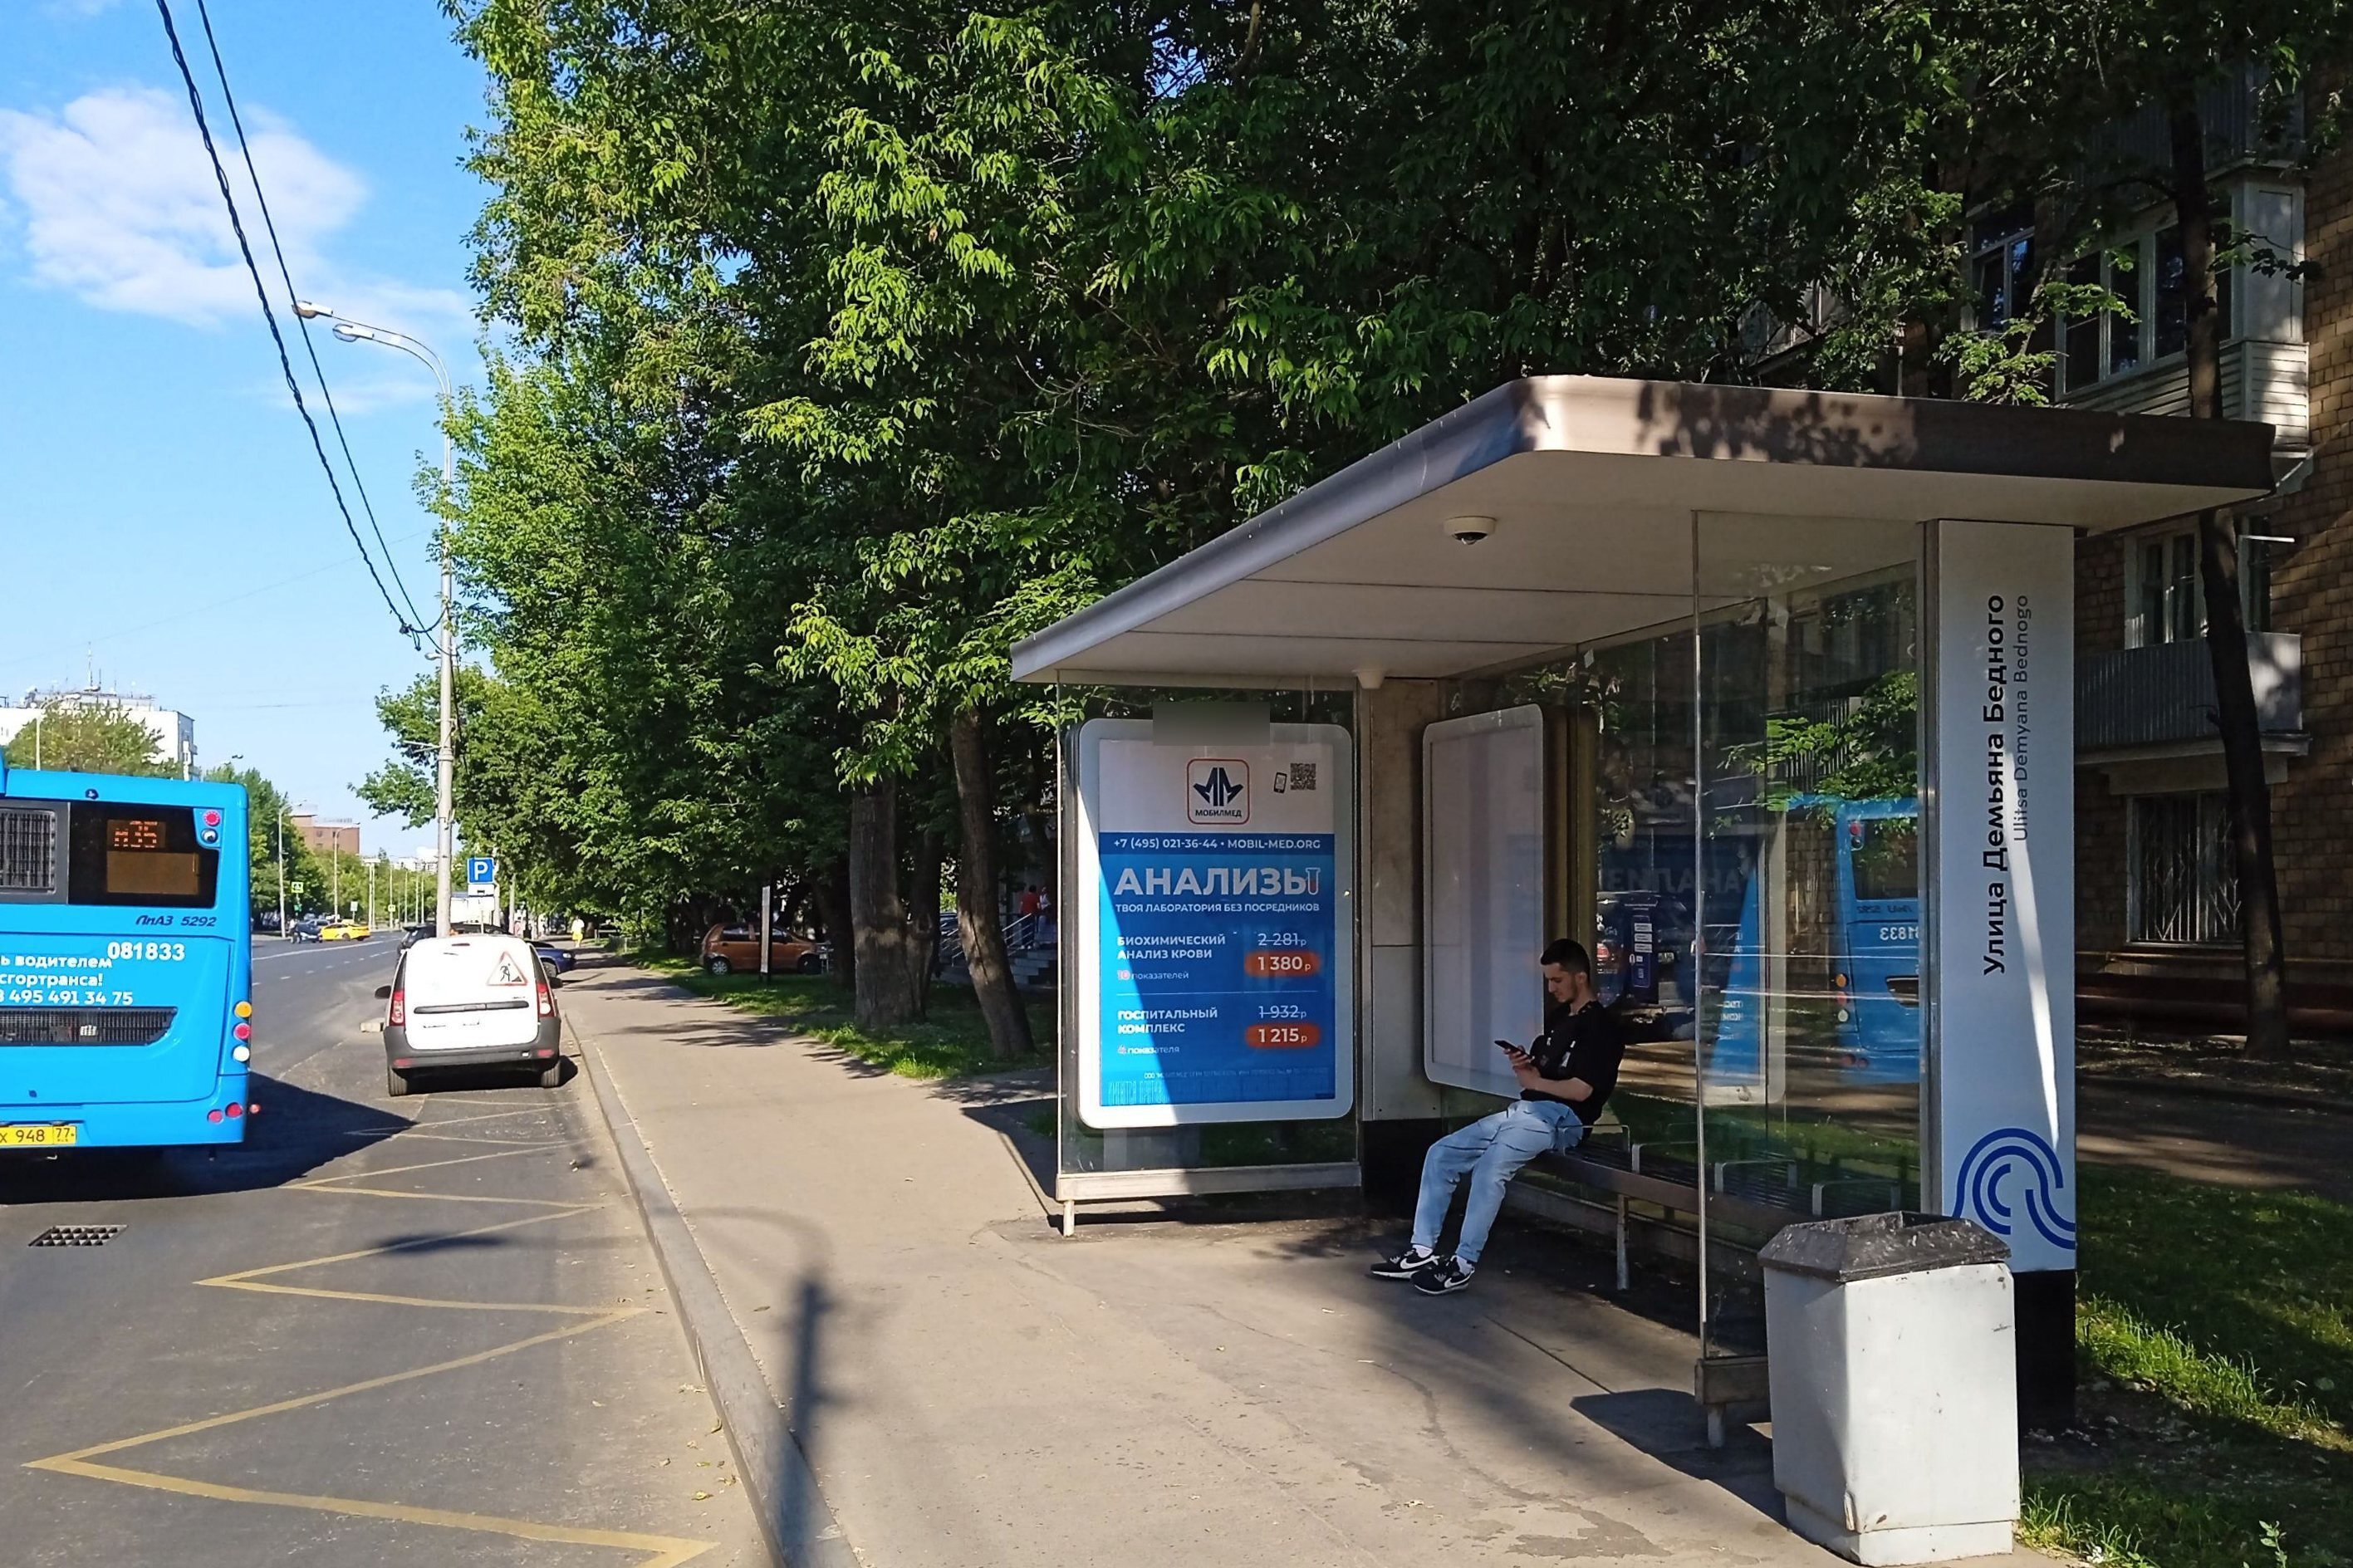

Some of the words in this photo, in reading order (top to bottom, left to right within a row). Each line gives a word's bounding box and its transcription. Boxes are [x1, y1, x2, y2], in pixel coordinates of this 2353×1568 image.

[2013, 595, 2032, 683] Bednogo
[1983, 595, 2007, 723] Бедного
[2013, 690, 2031, 781] Demyana
[1983, 733, 2007, 871] Демьяна
[1195, 810, 1243, 819] МОБИЛМЕД
[2013, 787, 2027, 841] Ulitsa
[1114, 839, 1127, 848] +7
[1130, 838, 1159, 849] (495)
[1163, 839, 1218, 848] 021-36-44
[1228, 839, 1321, 849] MOBIL-MED.ORG
[1115, 904, 1144, 913] ТВОЯ
[1145, 904, 1222, 913] ЛАБОРАТОРИЯ
[1224, 904, 1243, 912] БЕЗ
[1244, 904, 1320, 913] ПОСРЕДНИКОВ
[180, 916, 217, 927] 5292
[1983, 882, 2007, 975] Улица
[1117, 933, 1225, 946] БИОХИМИЧЕСКИЙ
[107, 941, 185, 961] 081833
[1117, 950, 1169, 959] АНАЛИЗ
[1172, 949, 1212, 958] КРОВИ
[15, 955, 113, 969] водителем
[1132, 970, 1189, 979] показателей
[9, 989, 43, 1004] 495
[48, 991, 79, 1004] 491
[84, 991, 106, 1005] 34
[112, 992, 133, 1006] 75
[1117, 1007, 1218, 1020] ГОСПИТАЛЬНЫЙ
[1118, 1023, 1185, 1035] КОМПЛЕКС
[16, 1129, 45, 1143] 948
[56, 1128, 70, 1139] 77
